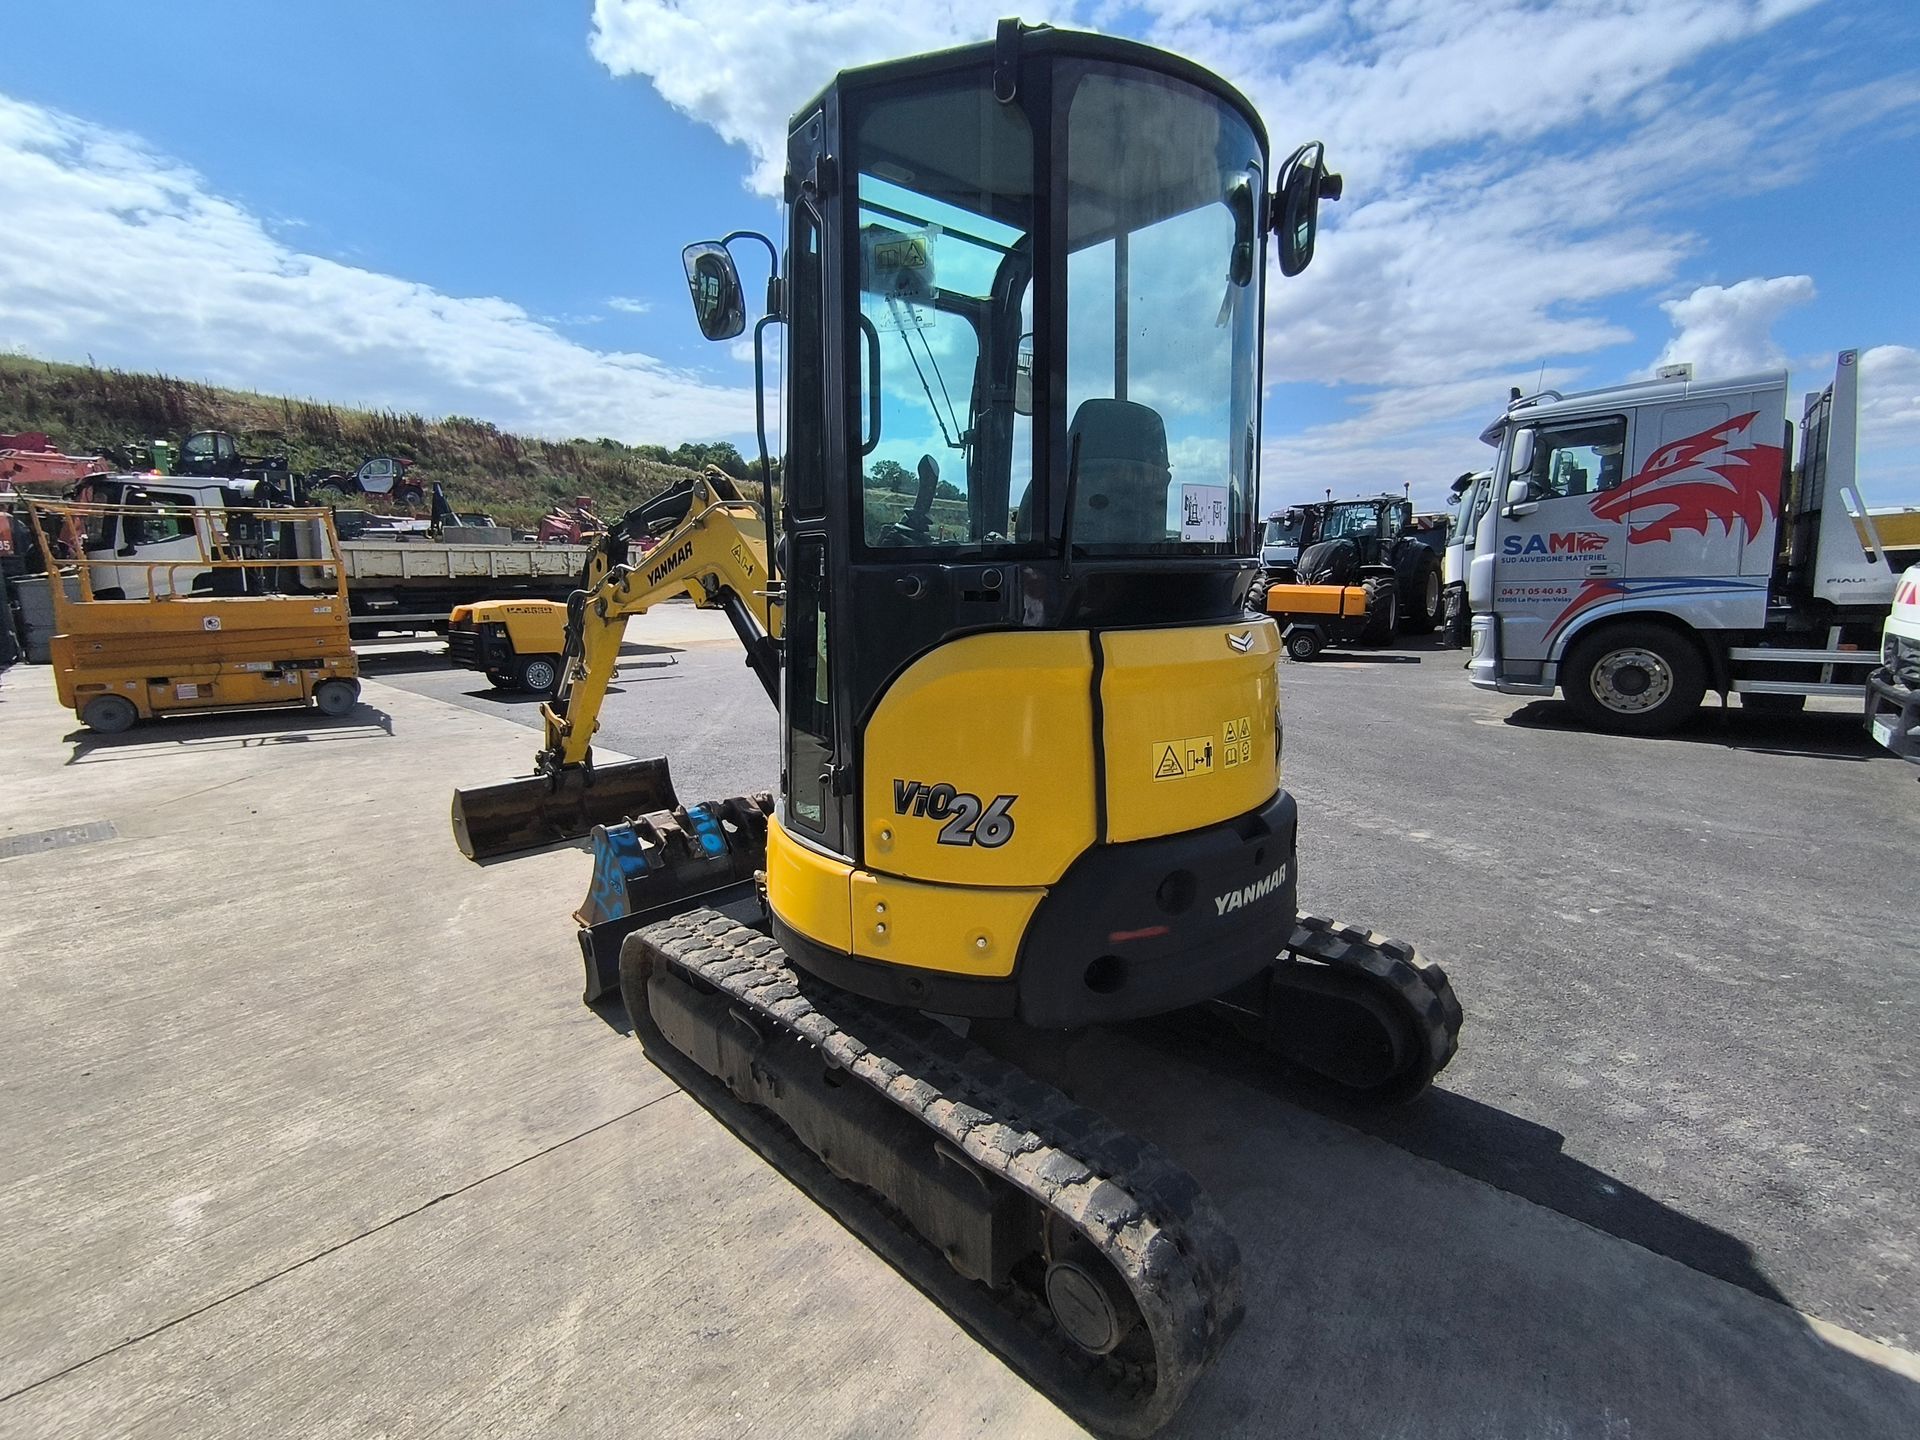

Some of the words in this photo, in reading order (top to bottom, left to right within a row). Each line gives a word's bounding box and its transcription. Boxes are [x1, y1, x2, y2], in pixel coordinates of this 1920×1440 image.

[1503, 532, 1577, 556] SAM
[647, 540, 693, 587] YANMAR
[1519, 555, 1563, 563] AUVERGNE
[1565, 553, 1607, 562] MATERIEL
[1556, 587, 1568, 595] 43
[1214, 862, 1287, 916] YANMAR
